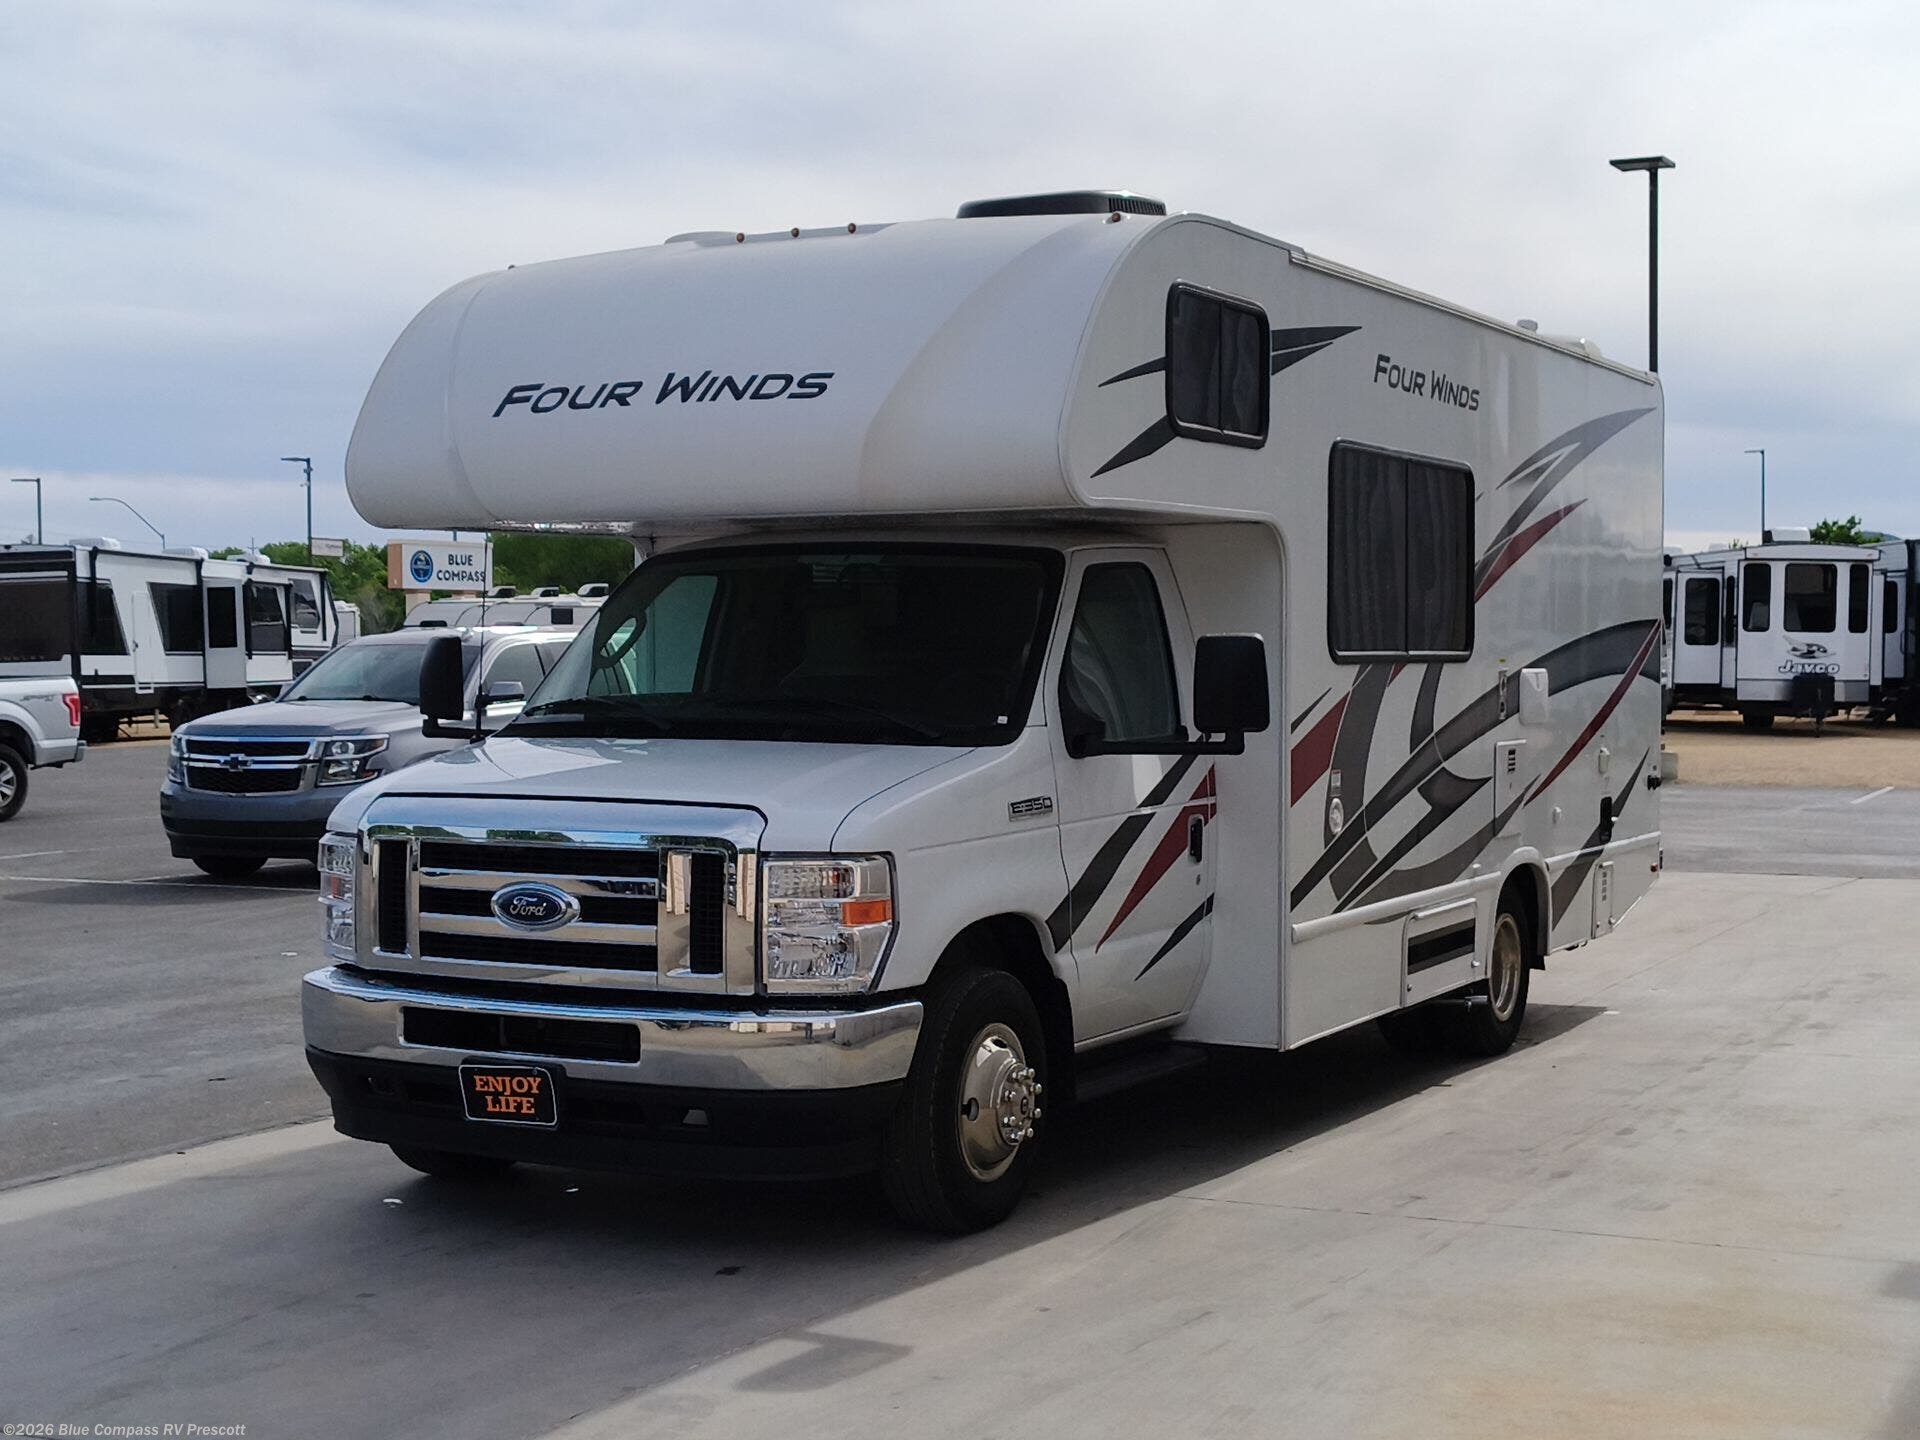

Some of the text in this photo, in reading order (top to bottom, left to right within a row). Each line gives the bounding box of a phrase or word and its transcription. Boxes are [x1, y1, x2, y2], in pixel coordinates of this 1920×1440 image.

[1373, 353, 1481, 411] FOUR WINDS
[492, 370, 836, 418] FOUR WINDS
[447, 554, 473, 566] BLUE
[436, 570, 486, 582] COMPASS
[509, 895, 547, 916] Ford
[473, 1075, 542, 1095] ENJOY
[485, 1095, 535, 1114] LIFE
